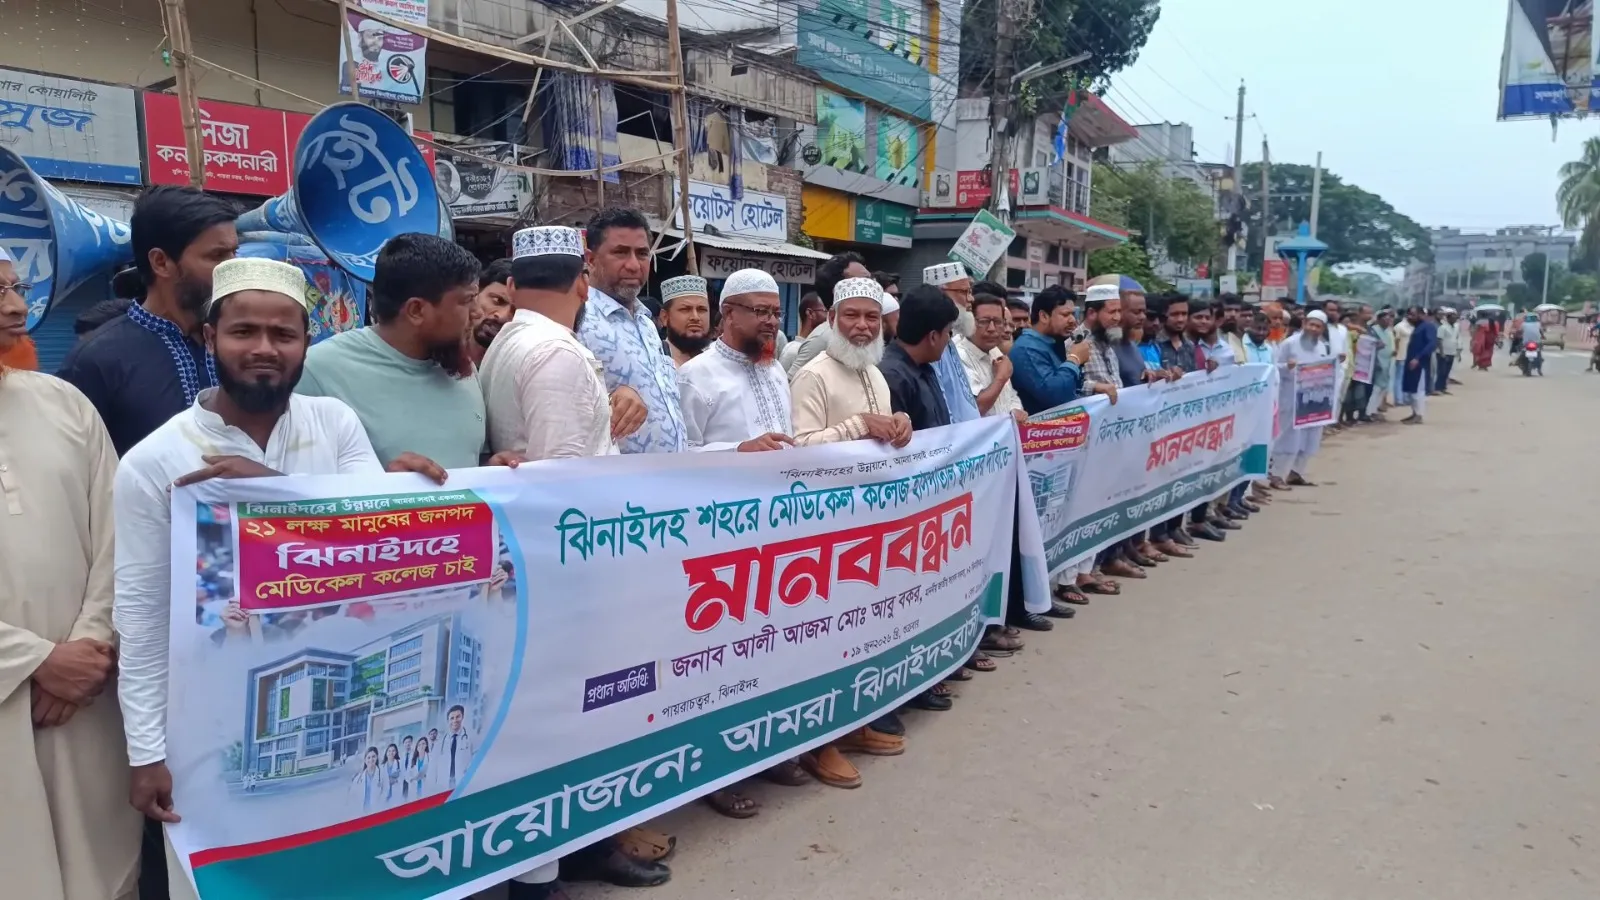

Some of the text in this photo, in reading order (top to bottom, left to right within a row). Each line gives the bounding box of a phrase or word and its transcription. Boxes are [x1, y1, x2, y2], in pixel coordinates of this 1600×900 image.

[678, 187, 784, 232] য়োটস্ হোটেল
[770, 260, 815, 279] হোটেল
[1146, 413, 1236, 472] মানববন্ধন
[245, 502, 337, 515] ঝিনাইদহের
[341, 498, 390, 512] উন্নয়নে
[246, 506, 477, 538] ২১ লক্ষ মানুষের জনপদ
[554, 502, 690, 565] ঝিনাইদহ
[696, 500, 762, 540] শহরে
[769, 481, 855, 528] মেডিকেল
[859, 476, 910, 512] কলেজ
[912, 463, 956, 500] হাসপাতাল
[275, 534, 461, 570] ঝিনাইদহে
[682, 491, 974, 633] মানববন্ধন
[255, 554, 478, 600] মেডিকেল কলেজ চাই
[671, 645, 727, 677] জনাব
[732, 624, 778, 659] আলী
[783, 615, 833, 645] আজম
[838, 606, 867, 632] মোঃ
[871, 595, 897, 619] আবু
[587, 682, 615, 704] প্রধান
[718, 677, 759, 701] ঝিনাইদহ
[719, 688, 843, 752] আমরা
[850, 604, 981, 712] ঝিনাইদহবাসী
